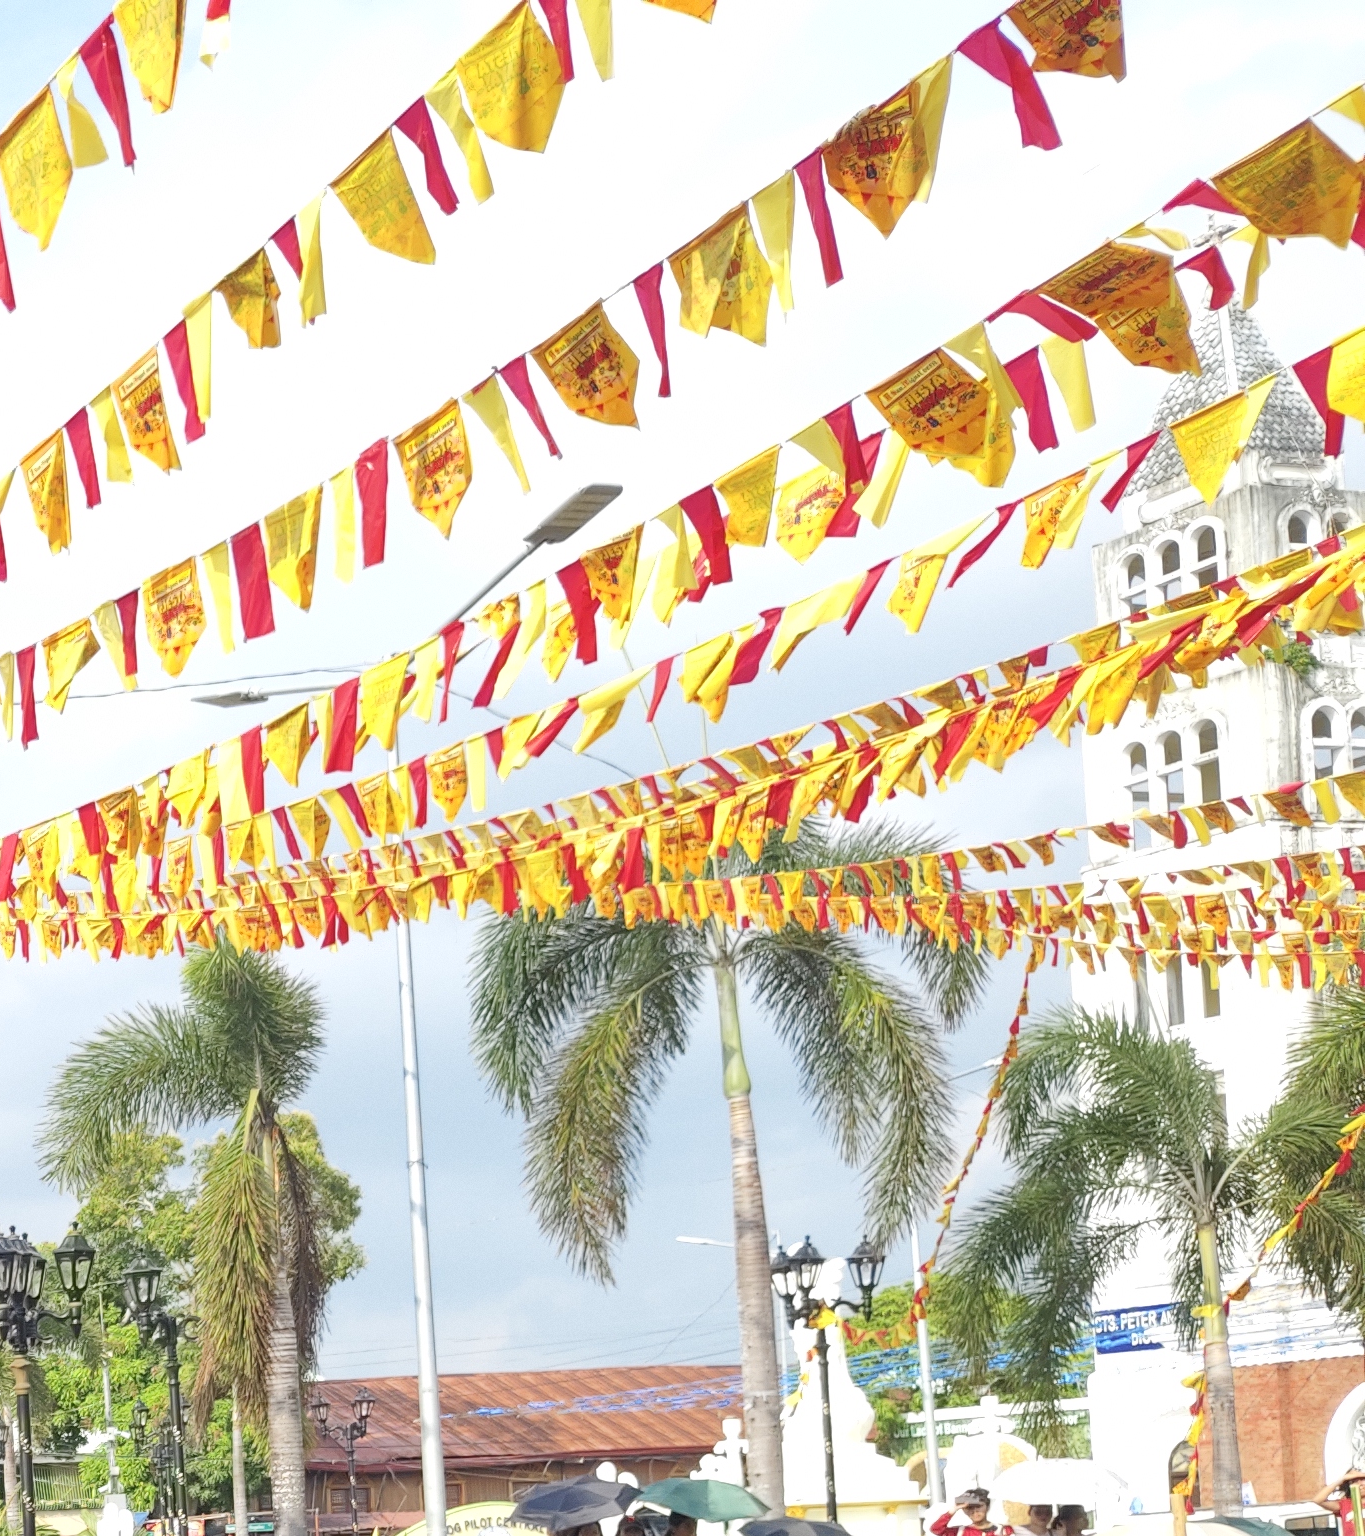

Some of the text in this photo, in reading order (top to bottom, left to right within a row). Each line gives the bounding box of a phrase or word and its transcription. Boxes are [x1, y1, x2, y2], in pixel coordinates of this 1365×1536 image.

[901, 374, 947, 412] FIESTA
[1120, 1311, 1157, 1330] PETER
[464, 1517, 494, 1532] PILOT
